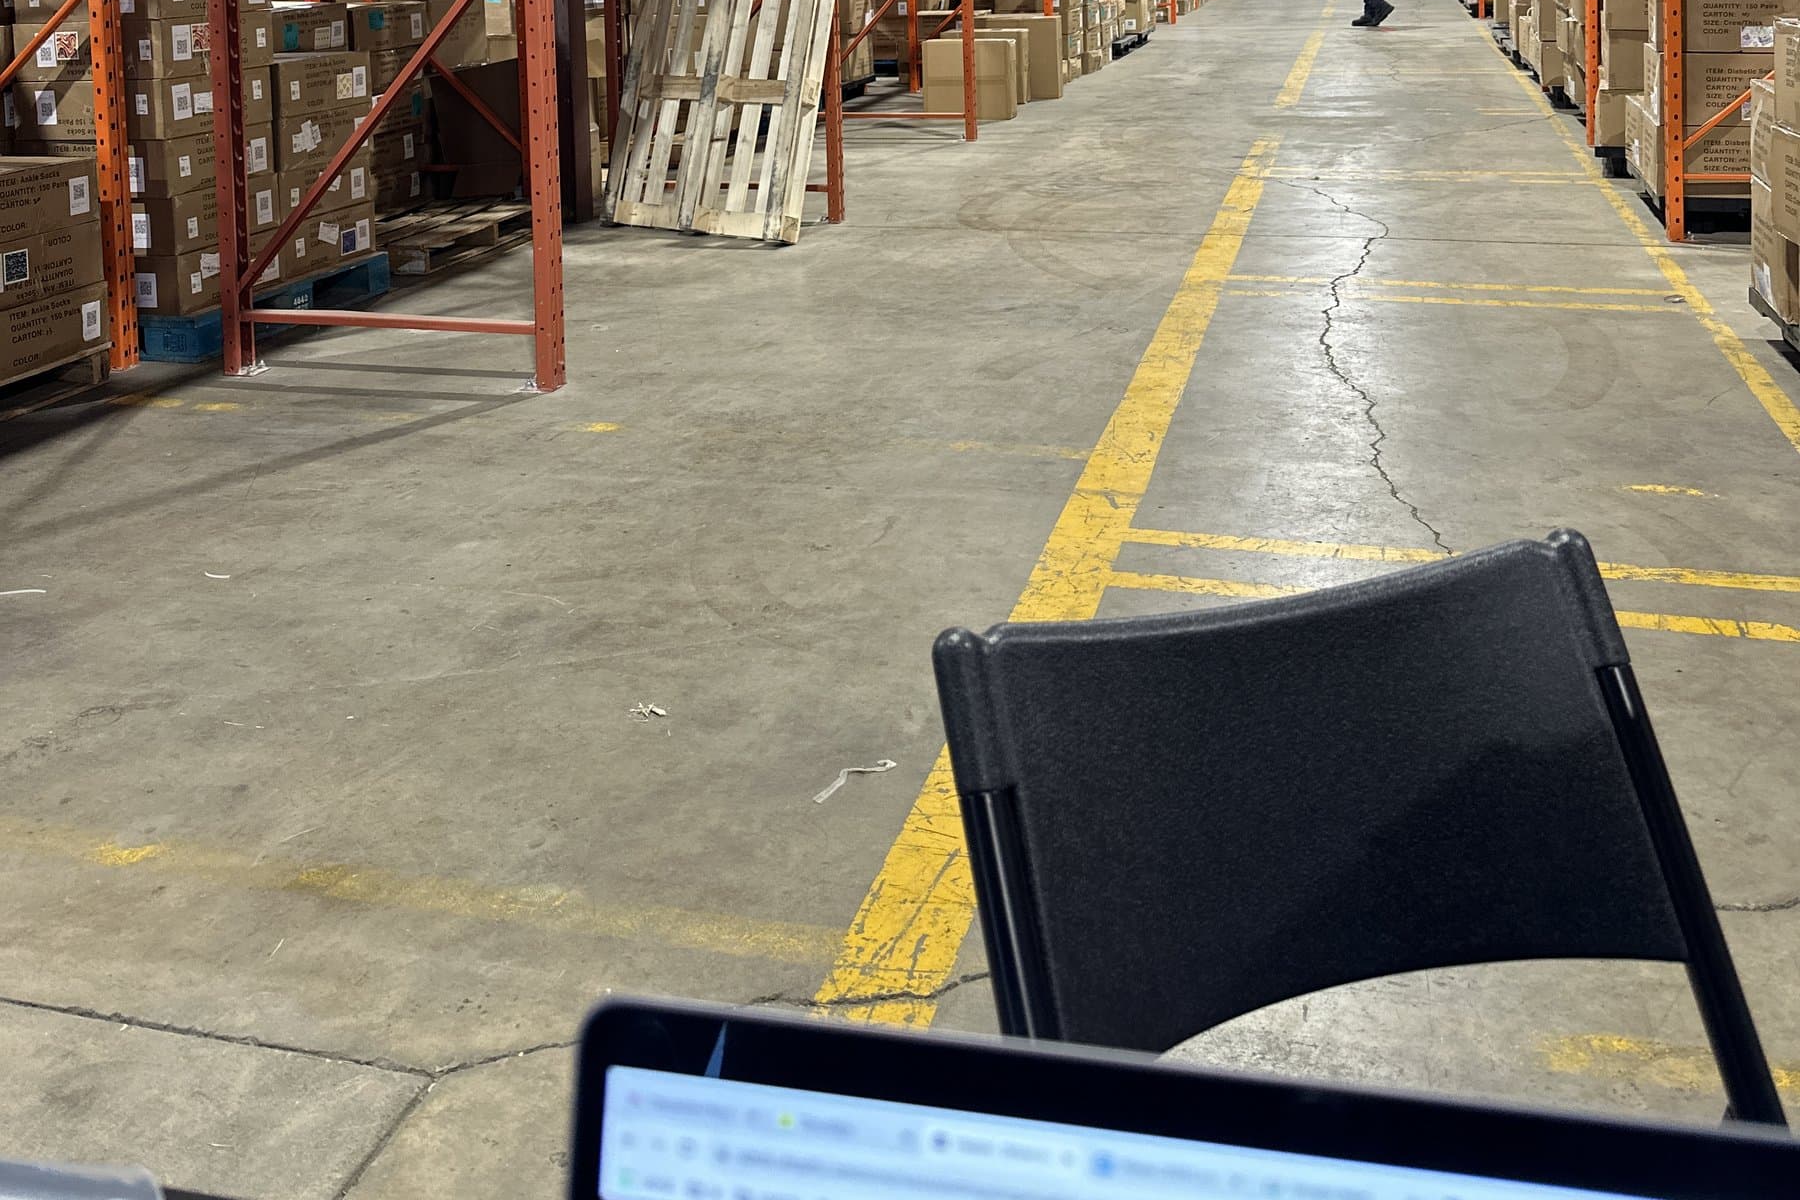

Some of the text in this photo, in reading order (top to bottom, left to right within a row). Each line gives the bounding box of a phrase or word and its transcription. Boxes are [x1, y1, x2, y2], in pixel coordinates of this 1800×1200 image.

[198, 156, 215, 165] CART
[21, 174, 39, 183] Ankle
[40, 171, 60, 180] Socks
[31, 303, 50, 315] Ankle
[51, 299, 71, 308] Socks
